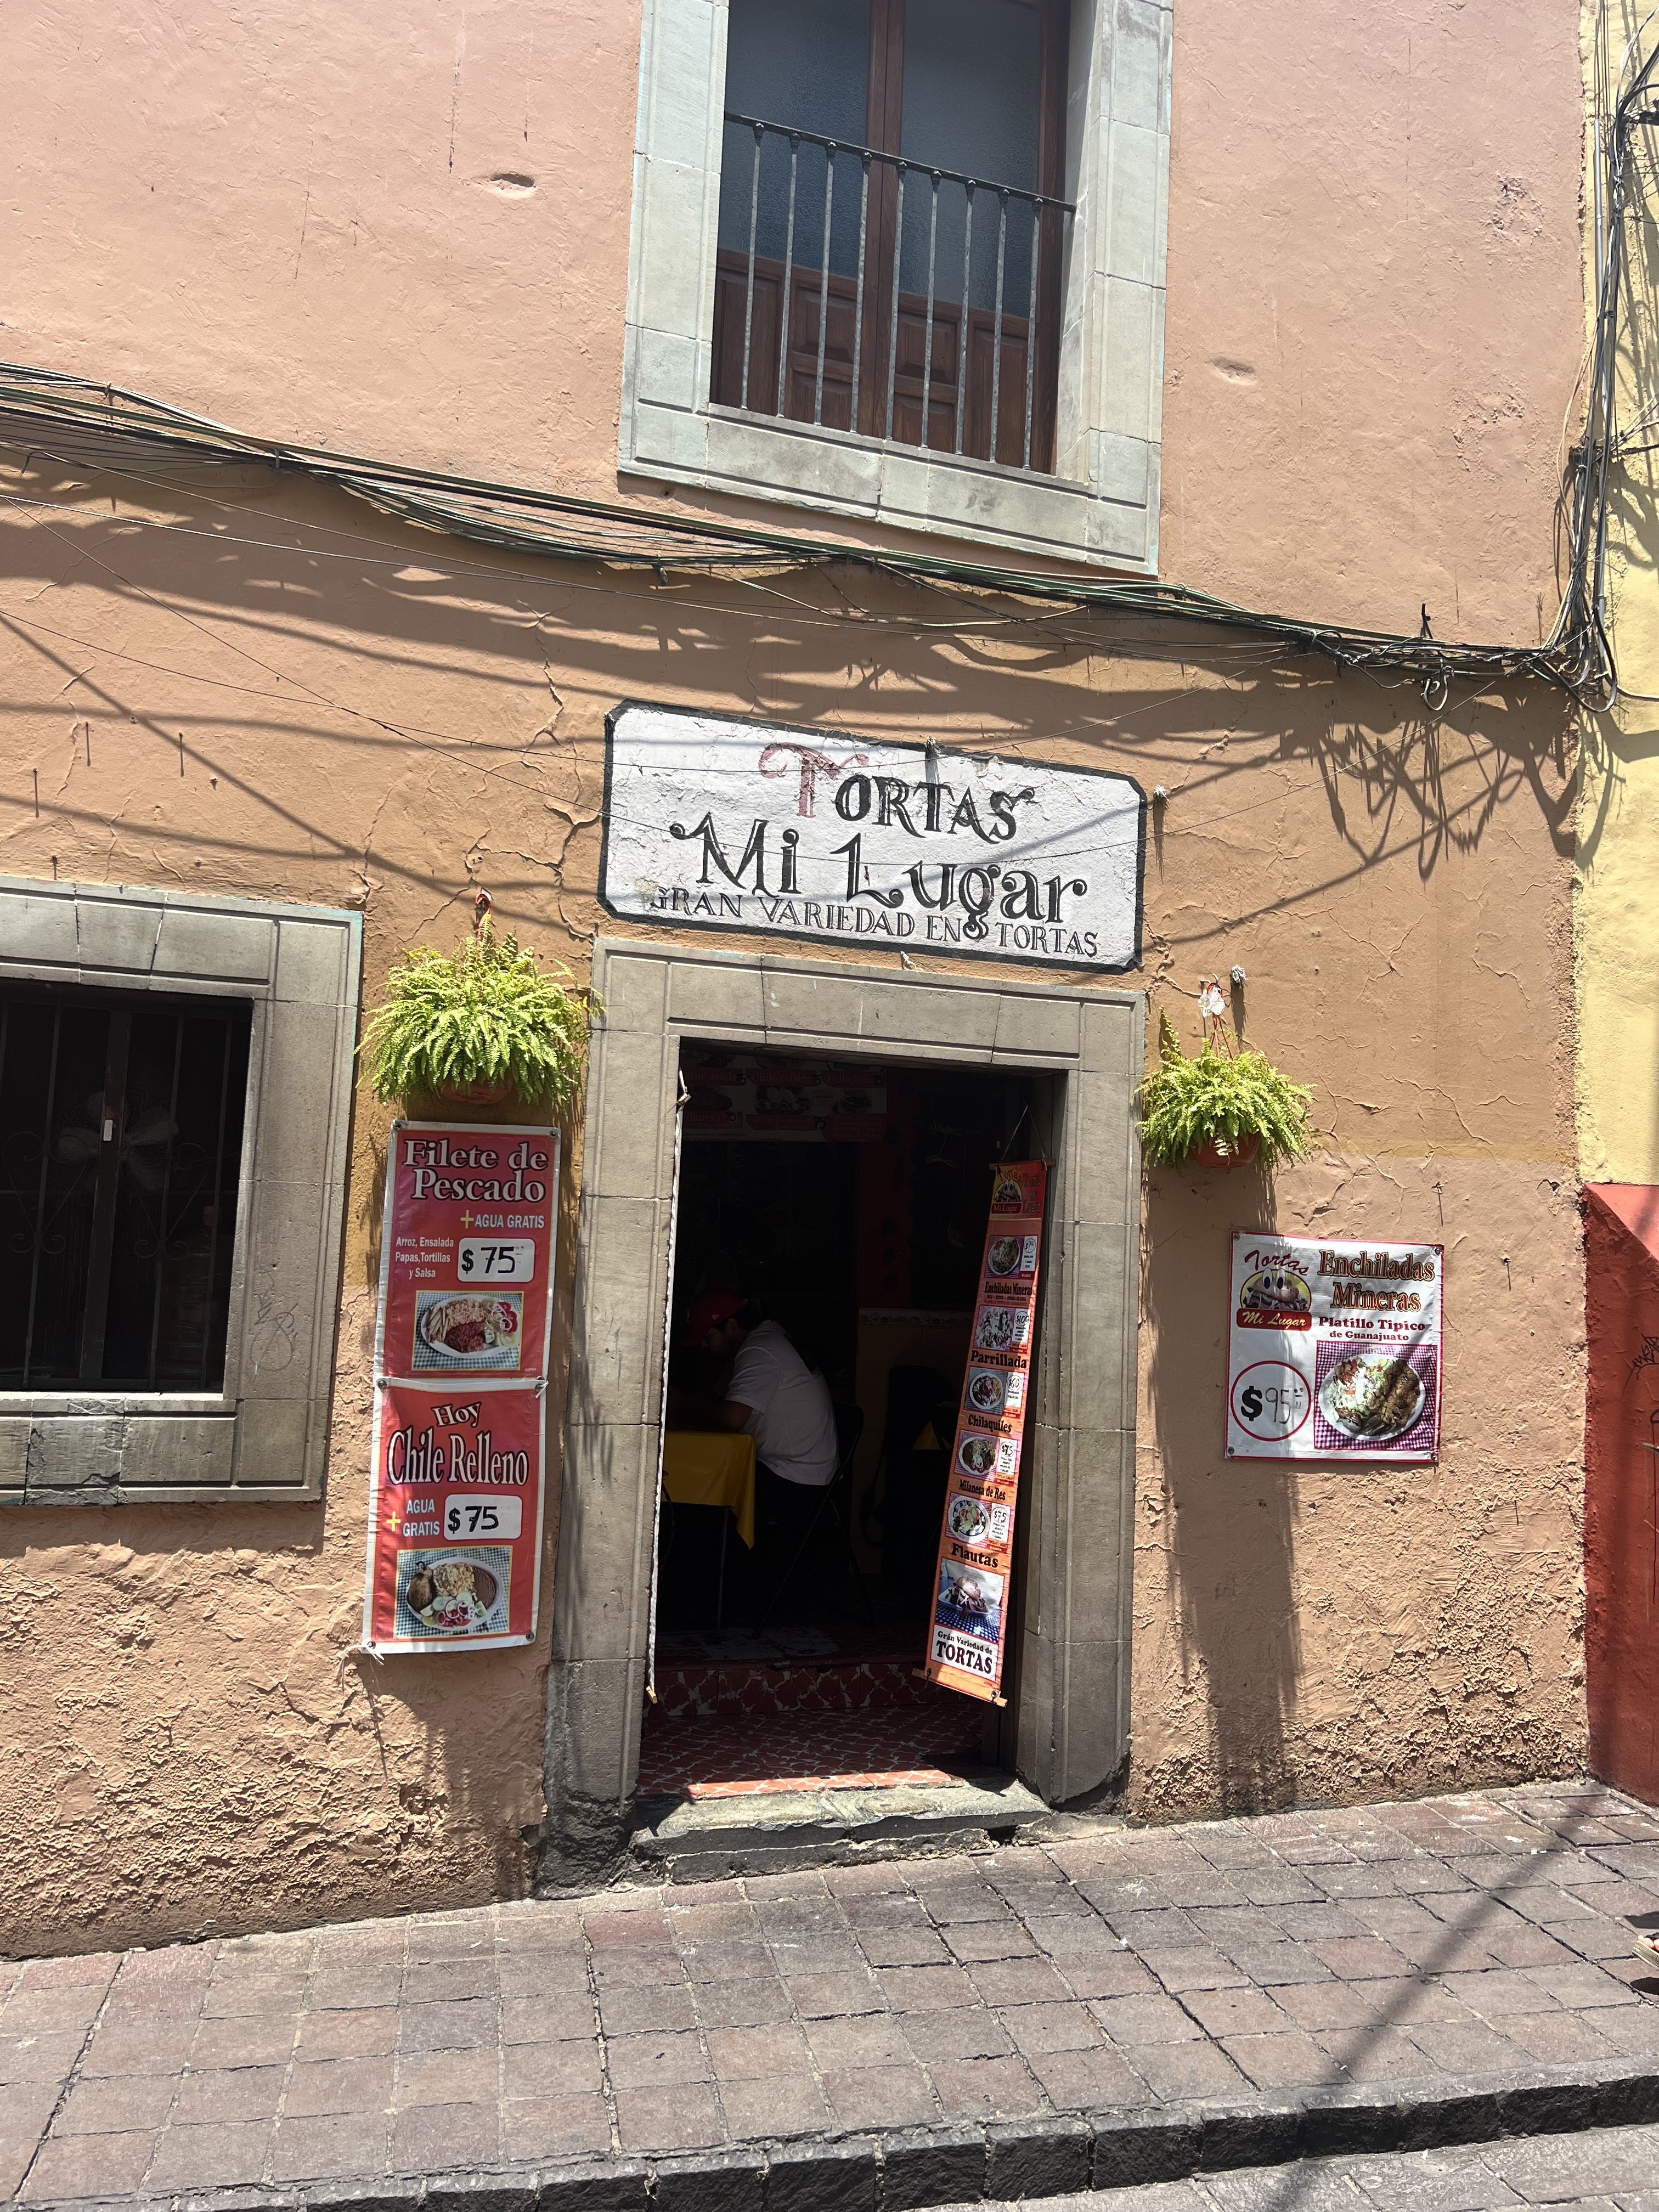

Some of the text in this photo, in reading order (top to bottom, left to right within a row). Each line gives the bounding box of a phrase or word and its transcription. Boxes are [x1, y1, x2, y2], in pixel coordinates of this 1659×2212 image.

[759, 742, 1035, 844] TORTAS
[670, 812, 1087, 943] Mi Lugar
[651, 885, 1098, 957] GRAN VARIEDAD EN TORTAS
[752, 1072, 777, 1082] Chile
[827, 1074, 850, 1084] Pollo
[403, 1138, 548, 1170] Filete de
[411, 1169, 546, 1202] Pescado
[475, 1214, 504, 1228] AGUA
[507, 1215, 544, 1228] GRATIS
[396, 1237, 454, 1248] Arroz, Ensalada
[1244, 1250, 1309, 1276] Tortas
[1318, 1250, 1435, 1281] Enchiladas
[409, 1268, 436, 1279] y Salsa
[984, 1281, 1032, 1296] Enchiladas Mineras
[1331, 1283, 1421, 1312] Mineras
[1242, 1311, 1306, 1327] Mi Lugar
[1318, 1317, 1425, 1332] Platillo Tipico
[1330, 1330, 1409, 1341] de Guanajuato
[970, 1350, 1027, 1369] Parrillada
[432, 1401, 481, 1428] Hoy
[968, 1414, 1012, 1433] Chilaquiles
[388, 1426, 528, 1486] Chile Relleno
[959, 1479, 1006, 1500] Milanesa de Res
[406, 1499, 435, 1514] AGUA
[403, 1521, 439, 1537] GRATIS
[448, 1506, 499, 1534] $75
[951, 1543, 998, 1568] Flautas
[956, 1636, 984, 1652] Variedad
[936, 1640, 992, 1674] TORTAS
